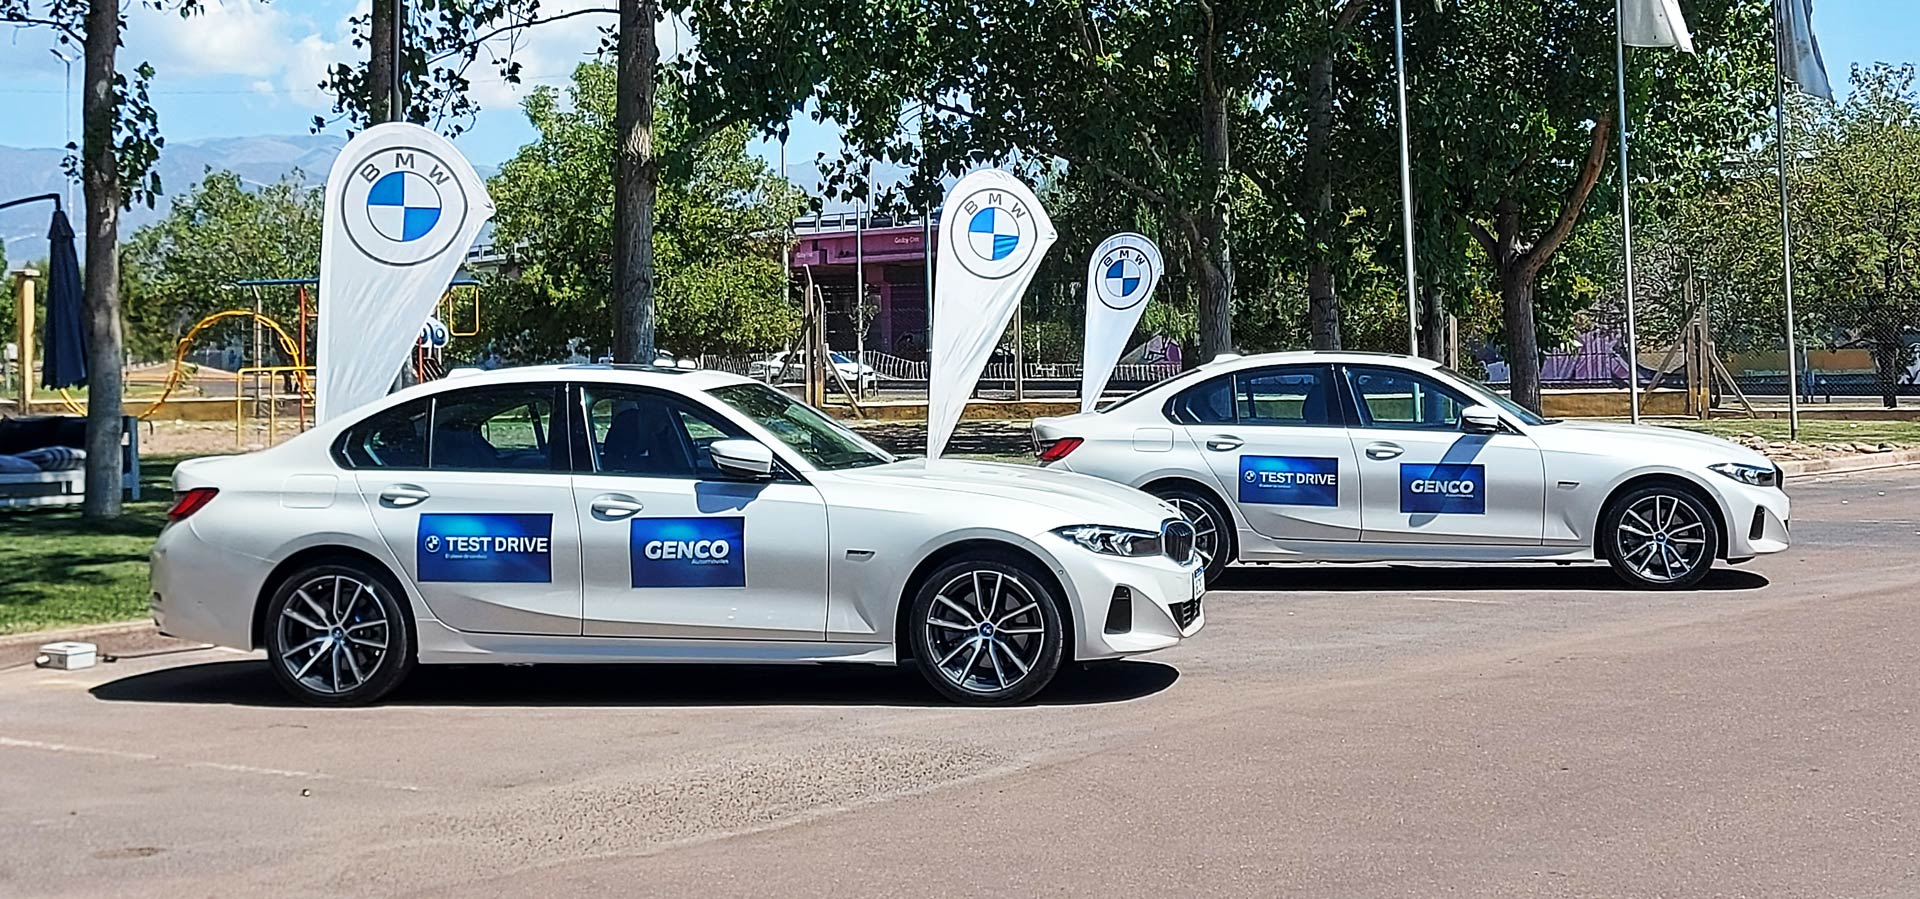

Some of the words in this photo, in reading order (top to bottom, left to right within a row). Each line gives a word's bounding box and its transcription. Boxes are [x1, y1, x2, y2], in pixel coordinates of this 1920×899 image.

[360, 153, 450, 186] BMW
[964, 193, 1026, 218] BMW
[1103, 250, 1146, 267] BMW
[1259, 471, 1294, 483] TEST
[1296, 473, 1336, 485] DRIVE
[1411, 479, 1474, 494] GENCO
[445, 536, 492, 552] TEST
[495, 537, 549, 552] DRIVE
[644, 540, 730, 559] GENCO
